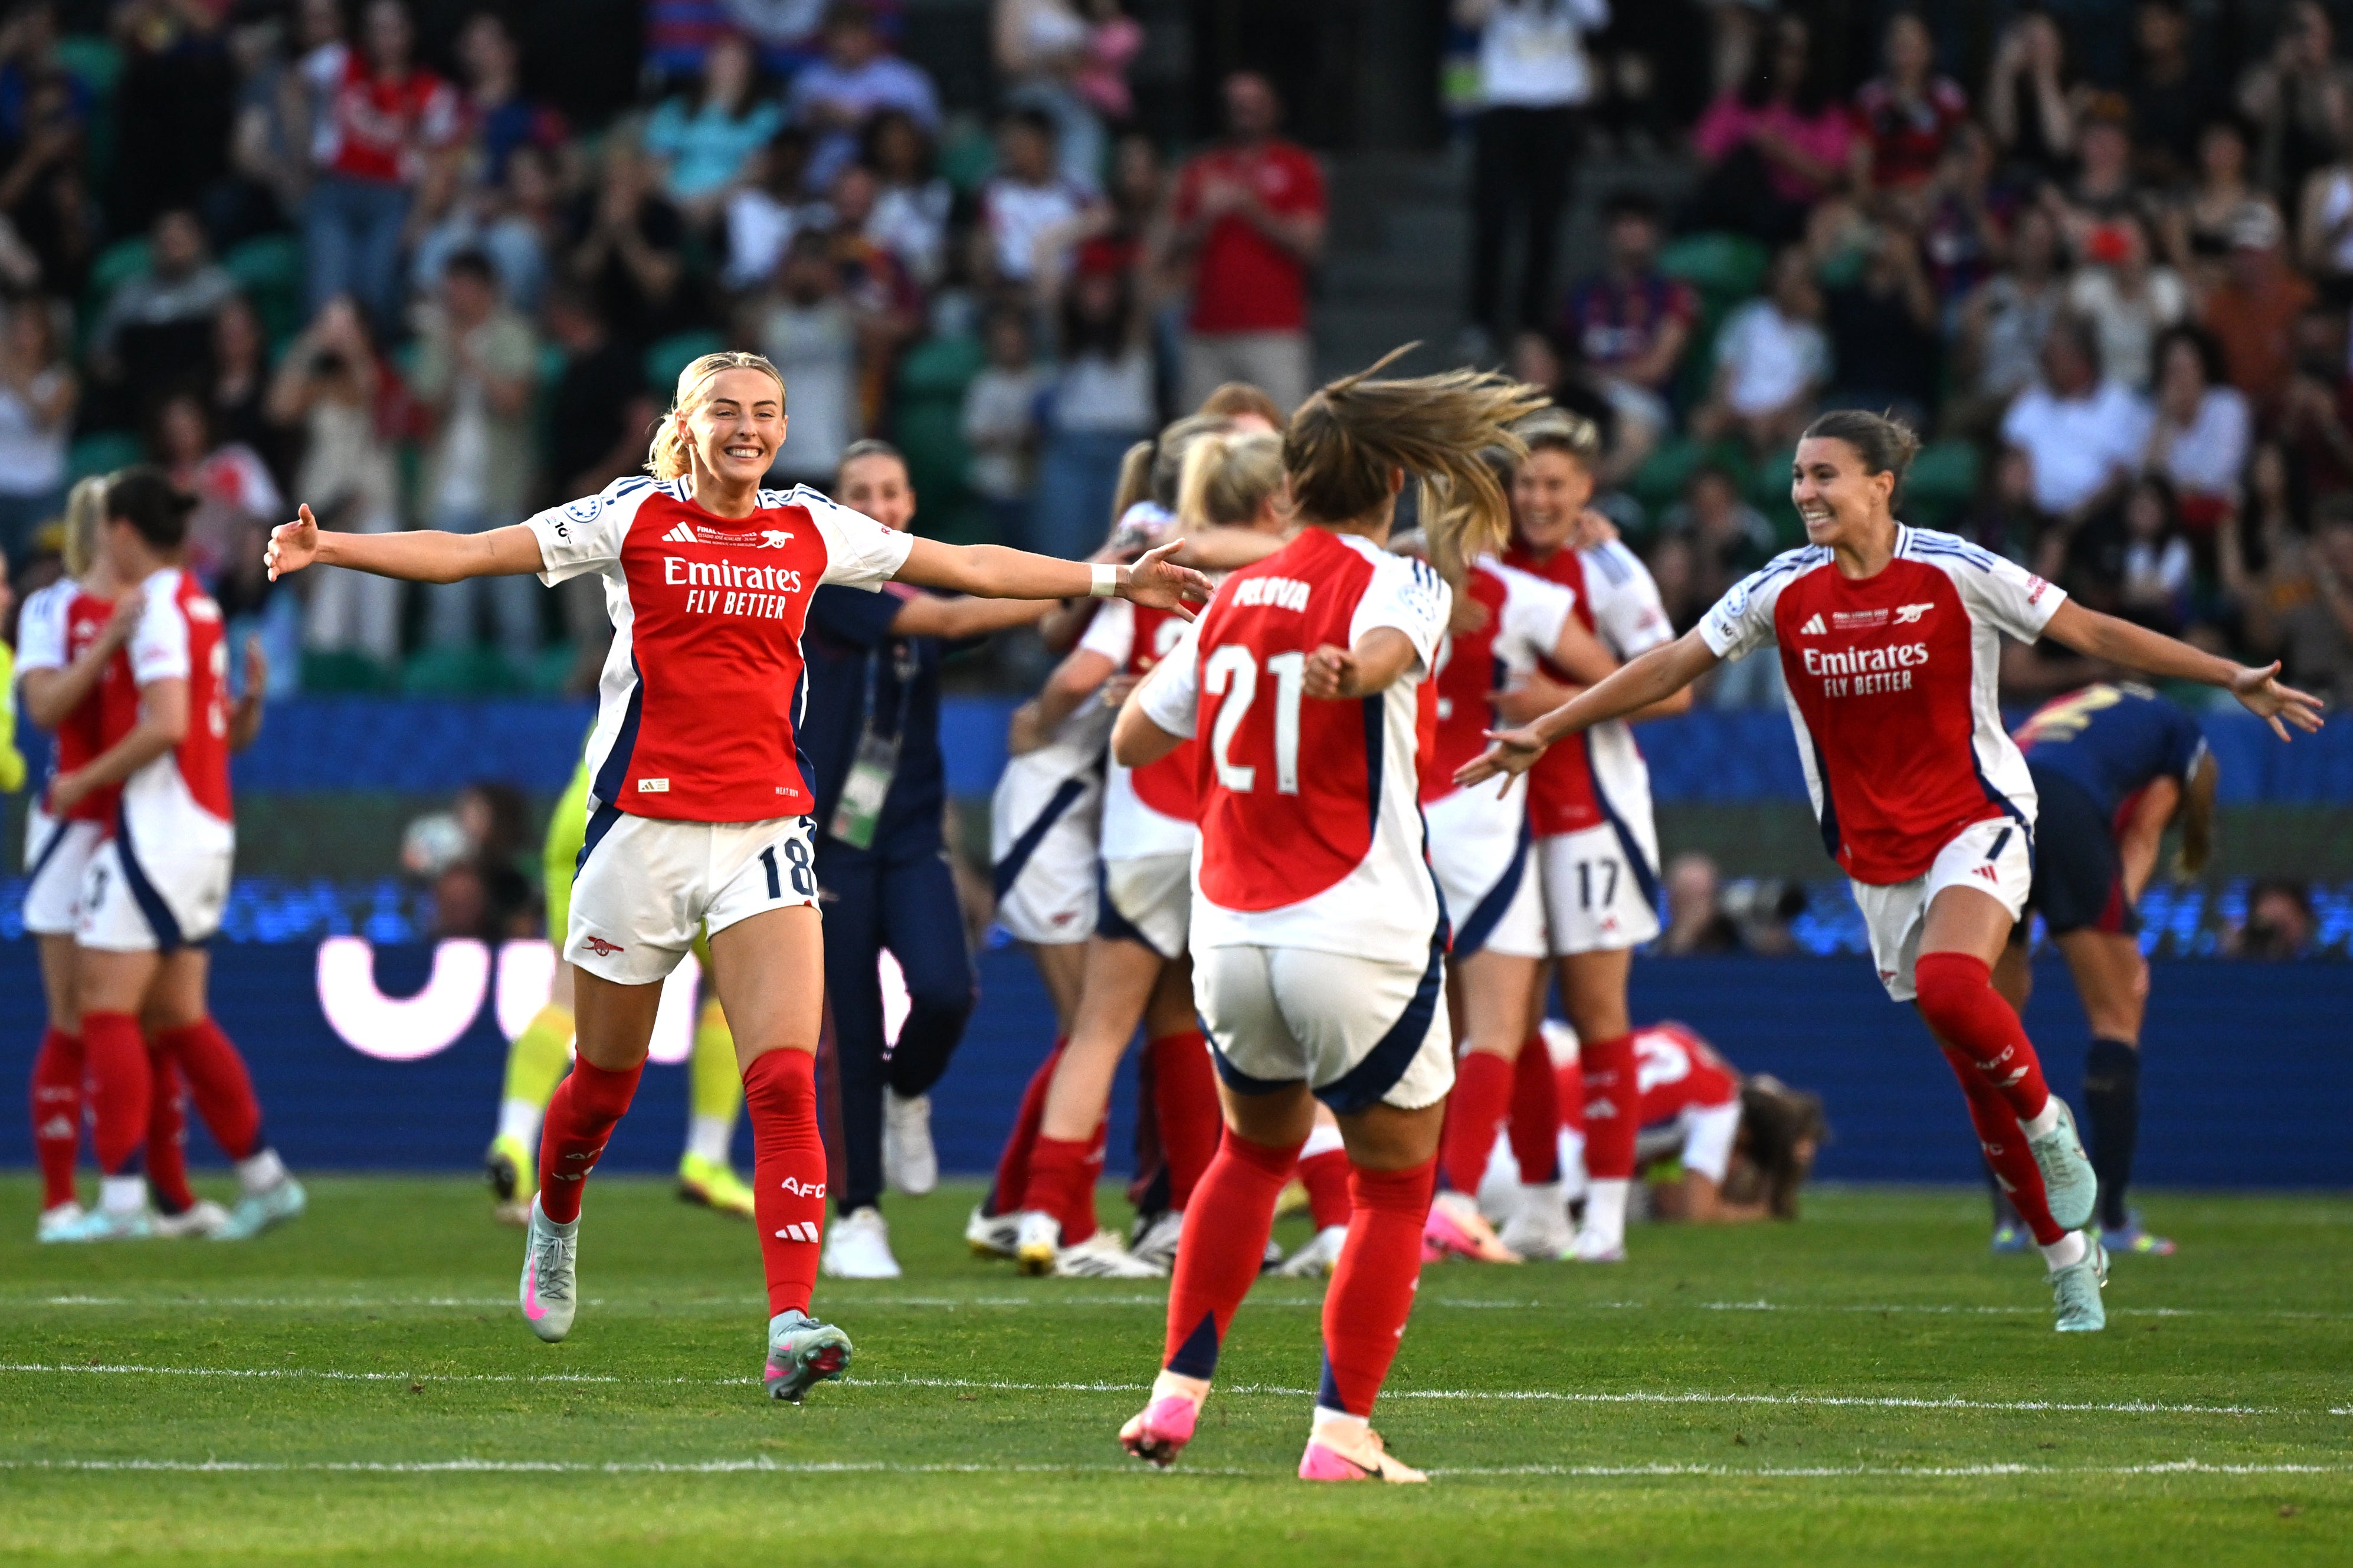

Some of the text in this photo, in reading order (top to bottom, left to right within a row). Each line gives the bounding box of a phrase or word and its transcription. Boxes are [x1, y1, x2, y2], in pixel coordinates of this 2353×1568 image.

[697, 526, 717, 534] FINAL
[663, 556, 801, 593] Emirates
[686, 590, 786, 619] FLY BETTER
[1803, 642, 1929, 675] Emirates
[1824, 670, 1912, 698] FLY BETTER
[1205, 644, 1306, 796] 21
[758, 837, 814, 900] 18
[1575, 857, 1619, 908] 17
[781, 1176, 825, 1199] AFC
